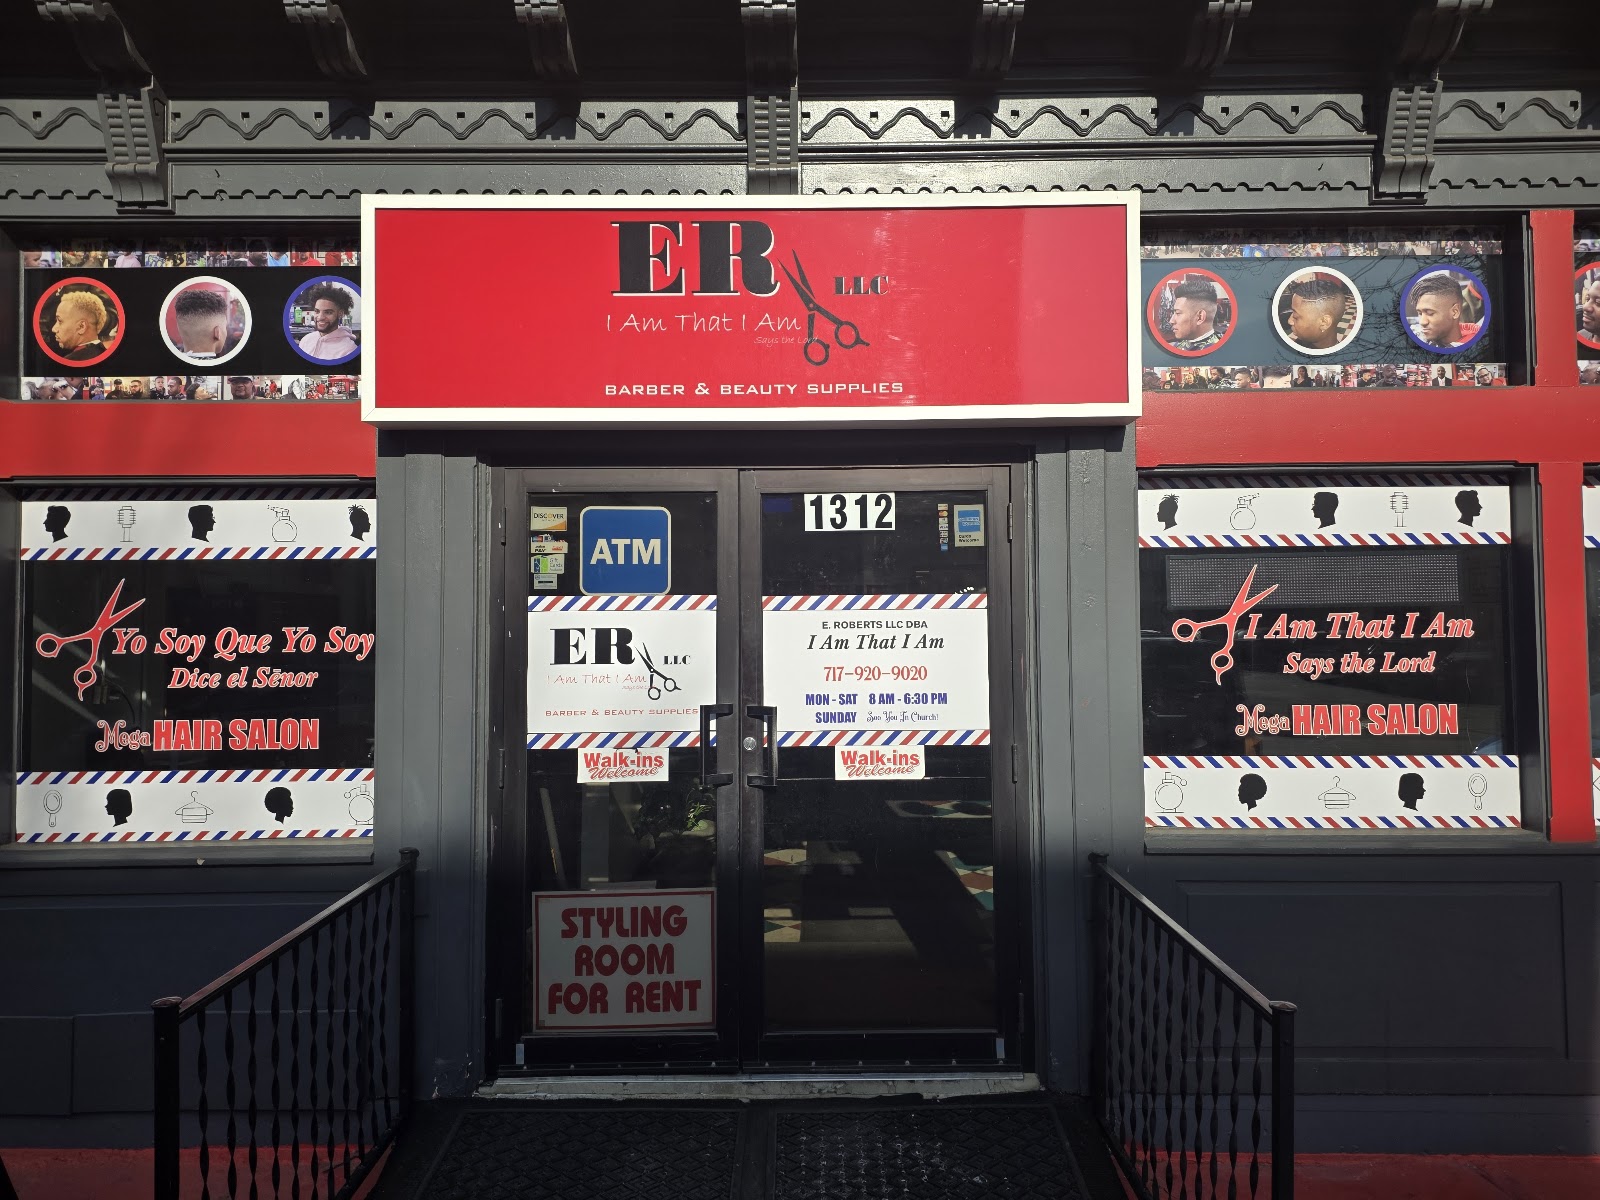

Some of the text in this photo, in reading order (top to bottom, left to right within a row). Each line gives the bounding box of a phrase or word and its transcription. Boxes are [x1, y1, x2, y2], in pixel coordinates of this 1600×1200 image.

[610, 220, 780, 297] ER
[833, 275, 889, 295] LLC
[606, 312, 802, 332] I Am That I Am
[781, 335, 794, 344] the
[605, 382, 904, 396] BARBER & BEAUTY SUPPLIES
[809, 493, 893, 530] 1312
[590, 538, 661, 565] ATM
[822, 620, 928, 629] E. ROBERTS LLC DBA
[1243, 612, 1475, 639] I Am That I Am
[112, 626, 375, 662] Yo Soy Que Yo Soy
[549, 627, 636, 665] ER
[807, 633, 945, 650] I Am That I Am
[663, 655, 692, 665] LLC
[1283, 651, 1436, 680] Says the Lord
[167, 667, 222, 689] Dice
[226, 666, 249, 689] el
[553, 674, 578, 684] Am
[582, 673, 611, 684] That
[622, 673, 647, 684] Am
[805, 693, 830, 705] MON
[838, 693, 858, 705] SAT
[868, 693, 876, 705] 8
[878, 693, 895, 705] AM
[903, 692, 929, 705] 6:30
[930, 692, 948, 704] PM
[545, 709, 587, 717] BARBER
[815, 711, 858, 724] SUNDAY
[883, 711, 898, 723] You
[910, 711, 939, 722] Church!
[1234, 703, 1459, 736] Mega HAIR SALON
[95, 718, 320, 752] Mega HAIR SALON
[583, 751, 665, 769] Walk-ins
[841, 750, 920, 766] Walk-ins
[588, 766, 659, 780] Welcome
[844, 765, 916, 778] Welcome
[561, 905, 688, 939] STYLING
[574, 943, 675, 977] ROOM
[548, 980, 701, 1015] FOR RENT
